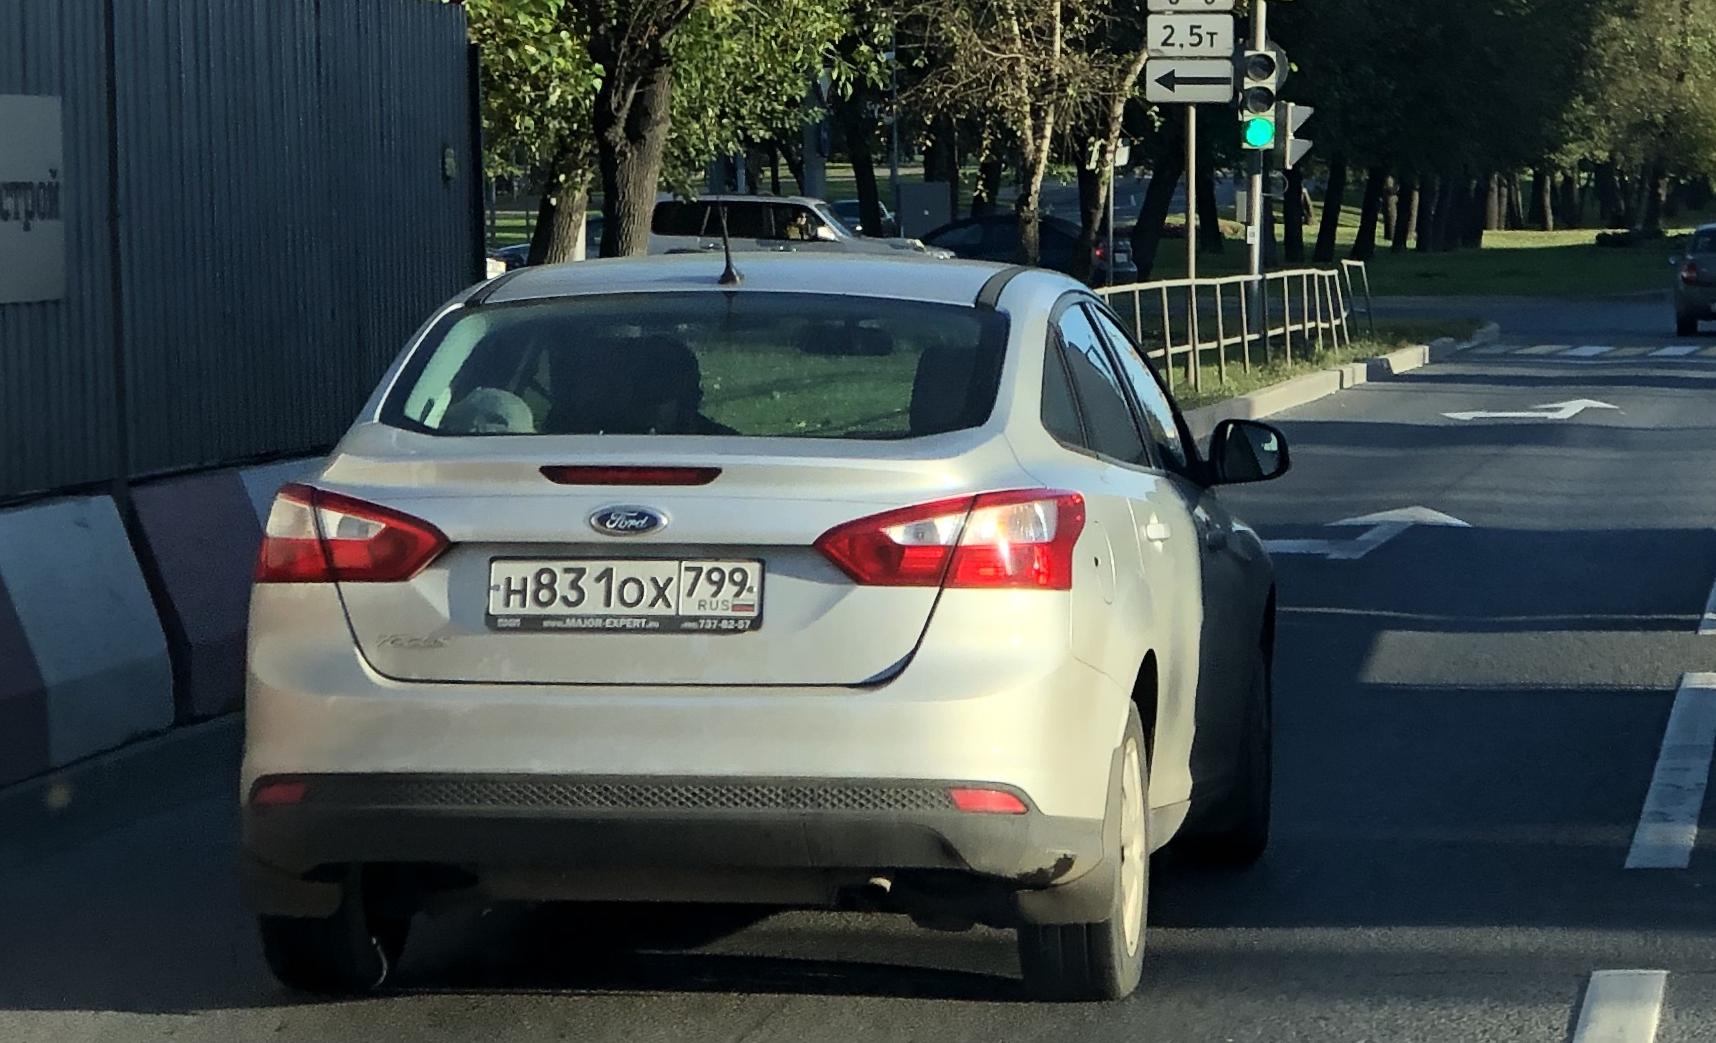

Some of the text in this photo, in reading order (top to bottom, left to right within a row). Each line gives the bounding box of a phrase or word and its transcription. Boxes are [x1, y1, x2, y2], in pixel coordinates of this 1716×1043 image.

[605, 511, 649, 529] Ford
[684, 566, 749, 598] 799
[698, 600, 730, 611] RUS
